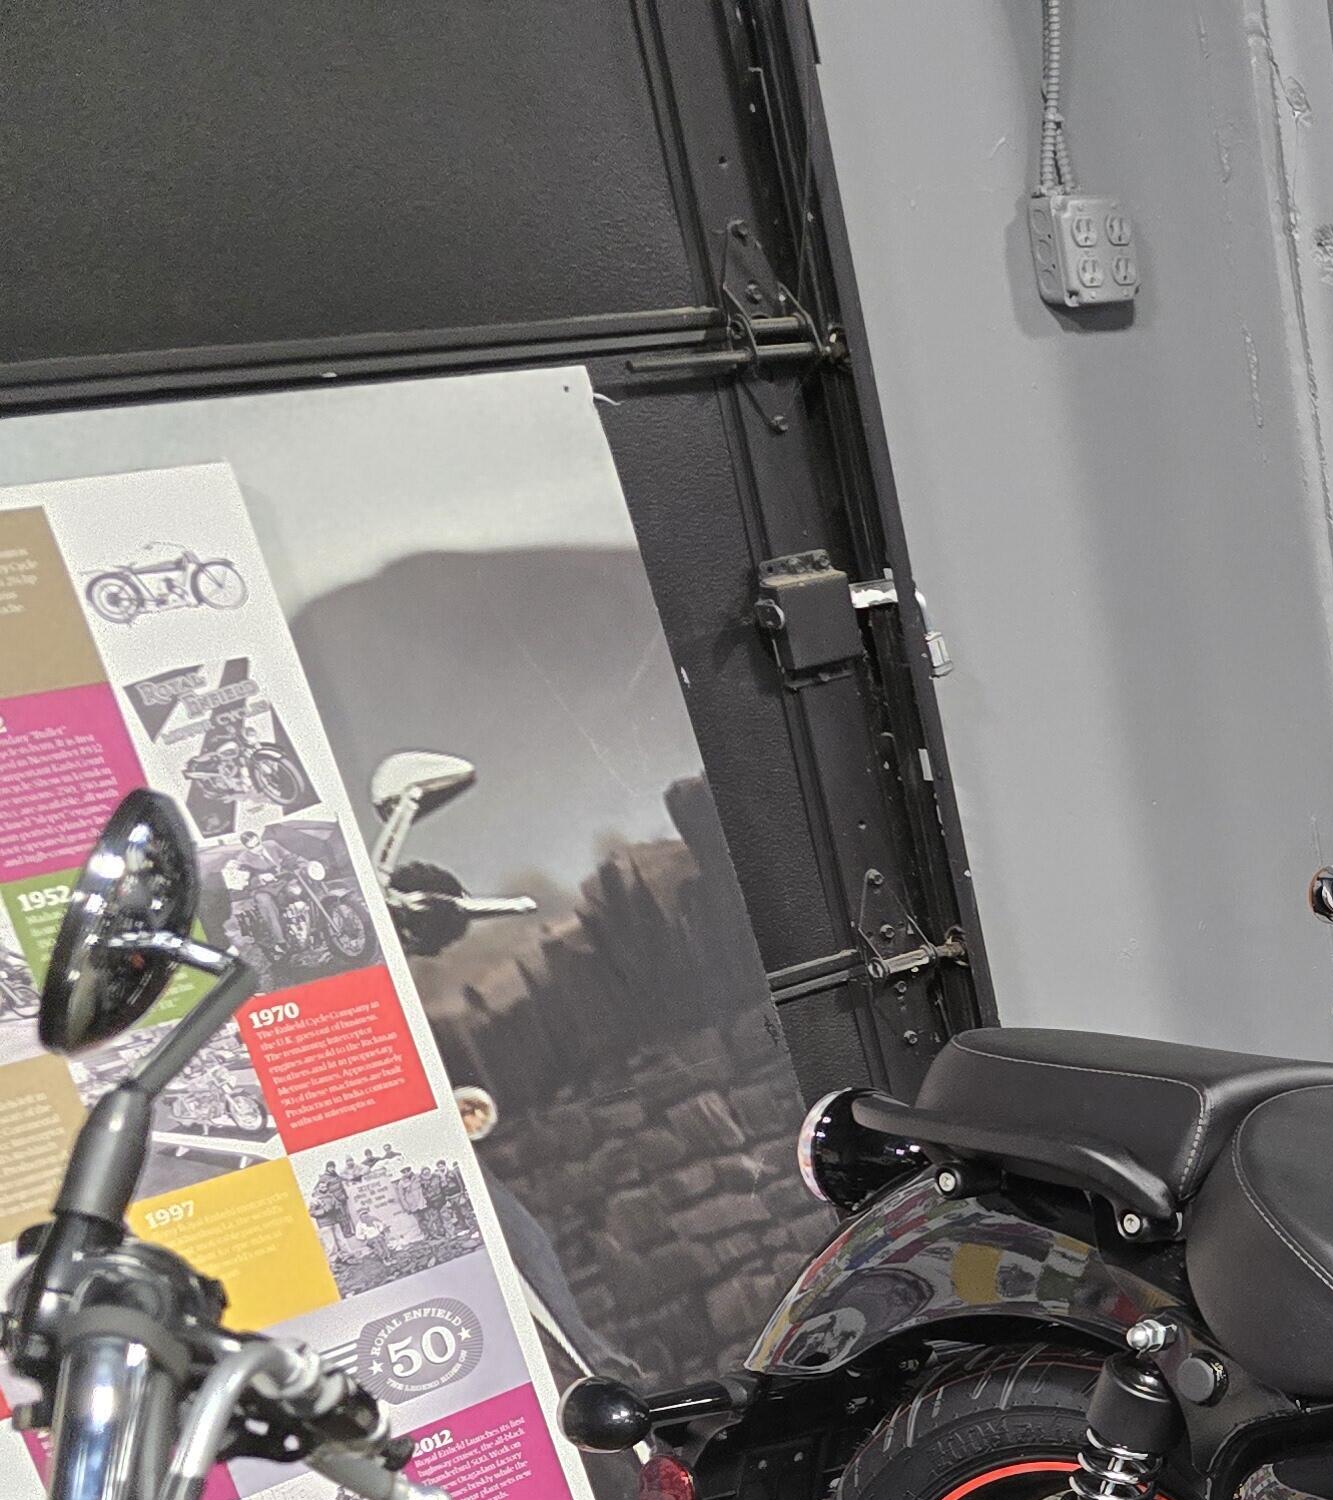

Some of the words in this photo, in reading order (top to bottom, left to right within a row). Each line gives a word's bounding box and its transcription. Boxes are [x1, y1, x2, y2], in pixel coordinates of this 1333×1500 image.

[17, 885, 73, 912] 1952
[249, 1002, 299, 1029] 1970
[145, 1200, 195, 1229] 1997
[370, 1319, 402, 1357] ROYAL
[403, 1308, 462, 1326] ENFIELD
[387, 1326, 456, 1378] 50
[386, 1378, 403, 1391] THE
[404, 1380, 440, 1392] LEGEND
[440, 1362, 462, 1383] RIDES
[458, 1349, 468, 1363] ON
[412, 1430, 453, 1458] 2012
[414, 1455, 437, 1468] Royal
[438, 1445, 465, 1458] Enfield
